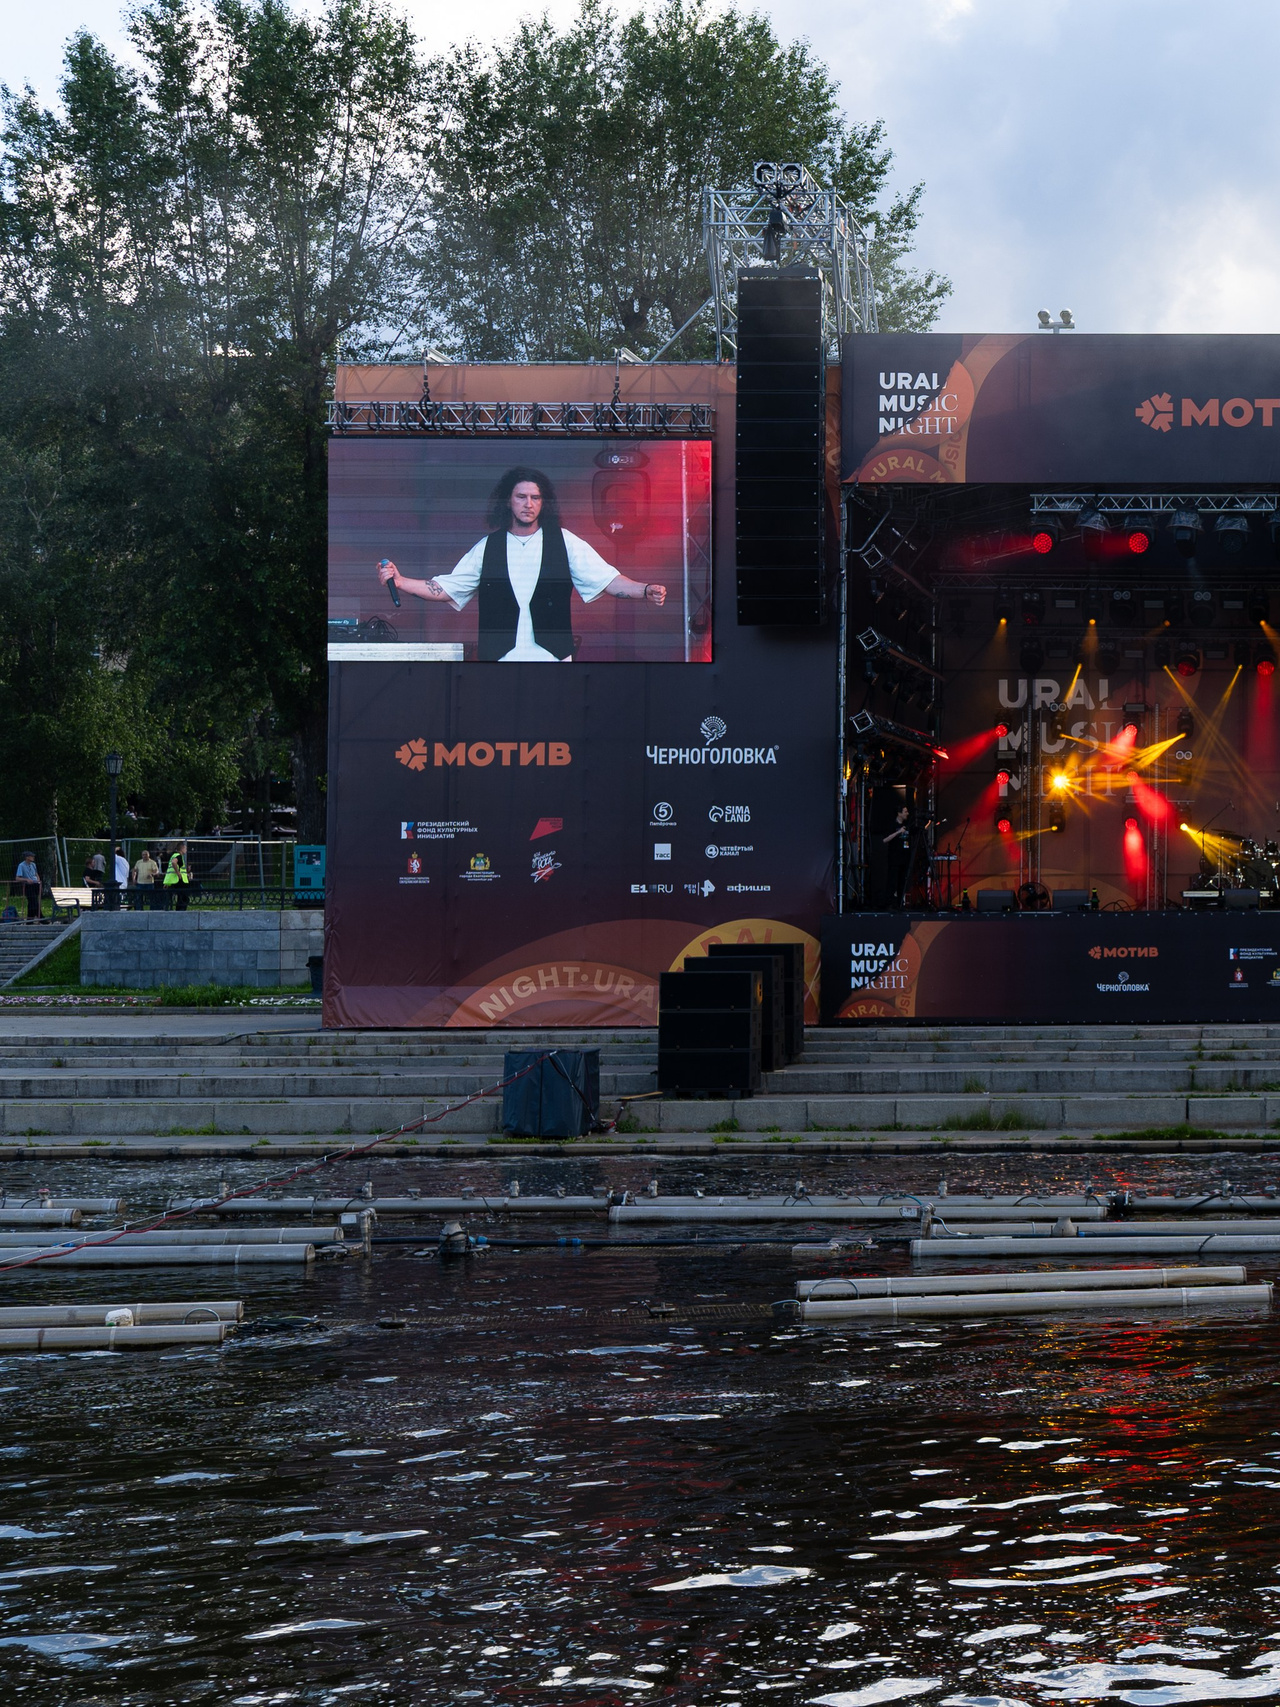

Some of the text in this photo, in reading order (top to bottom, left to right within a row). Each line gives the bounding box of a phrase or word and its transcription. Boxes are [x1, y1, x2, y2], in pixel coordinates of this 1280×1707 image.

[879, 372, 948, 391] URAL
[879, 393, 959, 413] MUSIC
[879, 416, 959, 436] NIGHT
[872, 456, 925, 478] URAL
[434, 741, 572, 767] МОТИВ
[725, 805, 751, 814] SIMA
[727, 883, 771, 893] афиша
[851, 943, 900, 957] URAL
[1104, 947, 1159, 958] МОТИВ
[851, 958, 908, 973] MUSIC
[851, 976, 909, 990] NIGHT
[478, 965, 658, 1021] NIGHT URA
